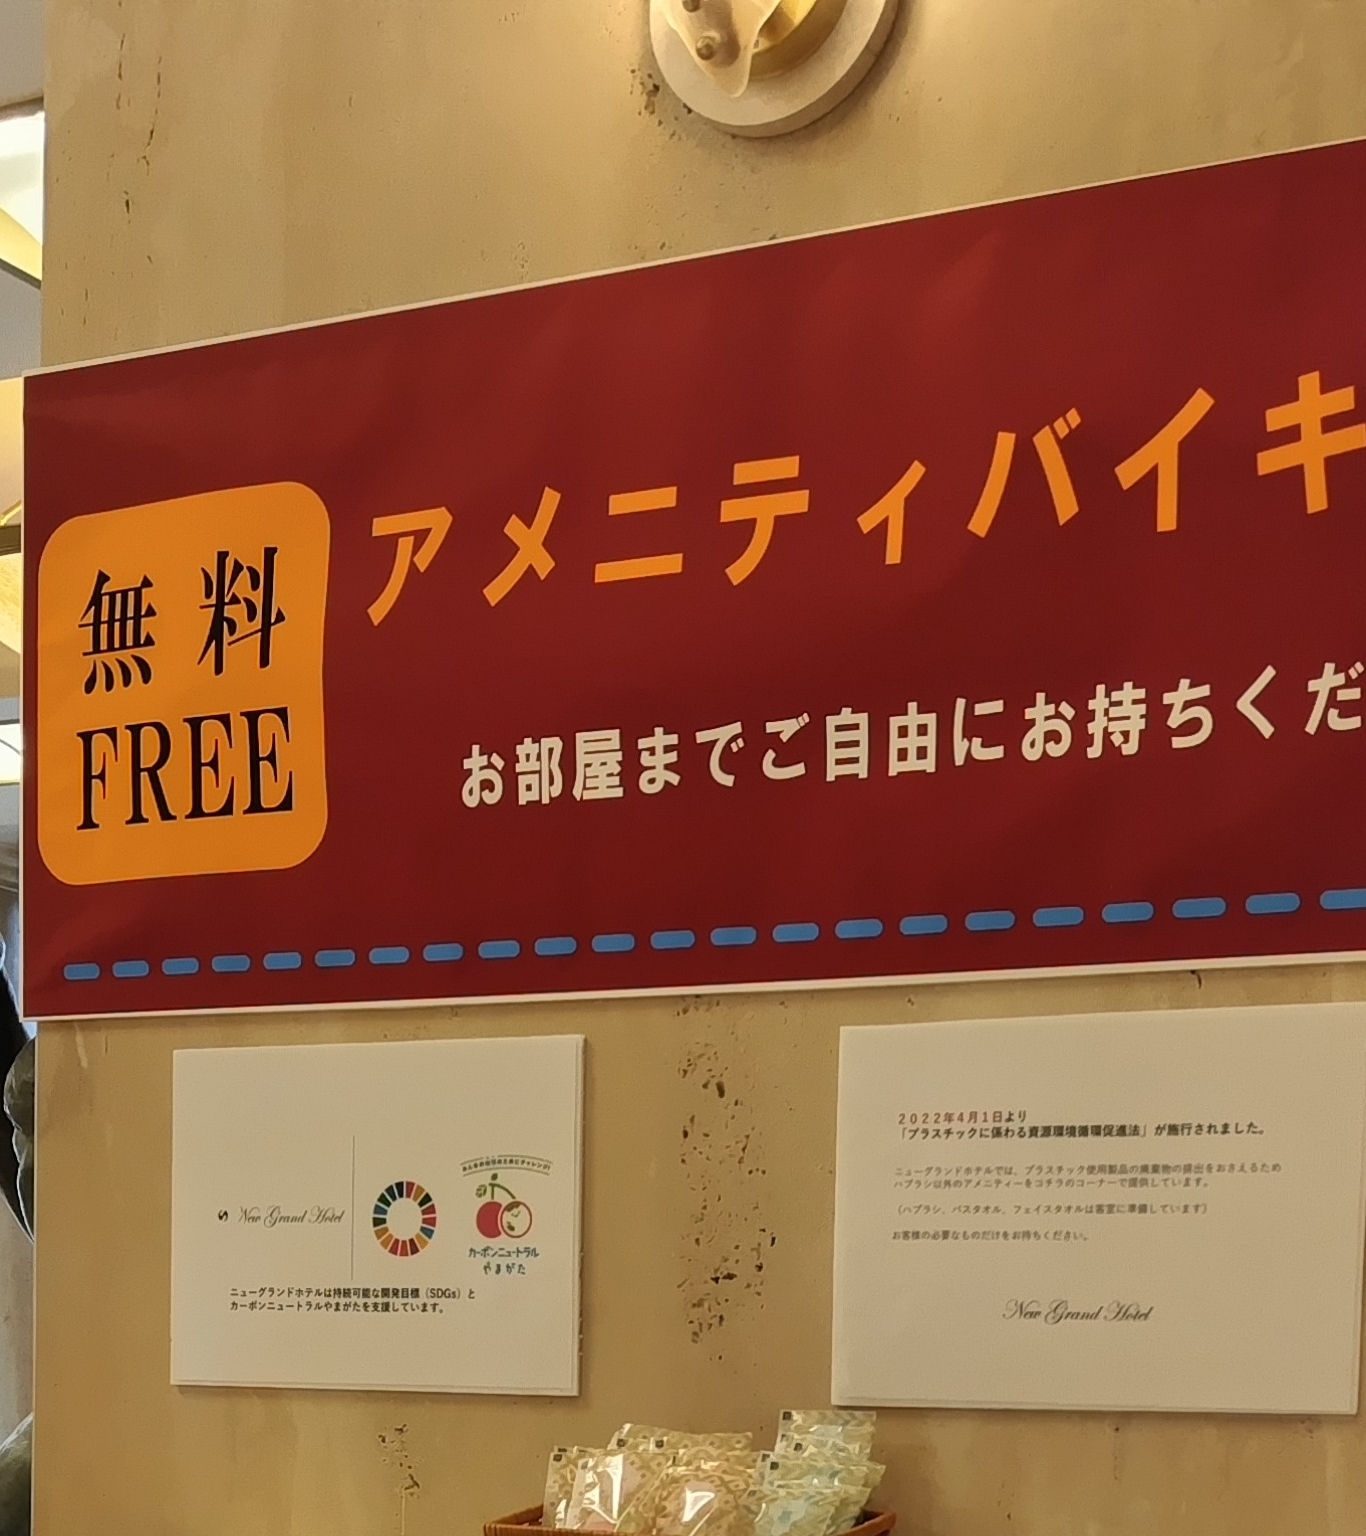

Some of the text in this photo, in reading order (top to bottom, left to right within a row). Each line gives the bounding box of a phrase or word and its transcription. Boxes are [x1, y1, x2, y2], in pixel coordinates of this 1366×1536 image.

[78, 547, 285, 694] 無料
[77, 707, 292, 830] FREE
[237, 1204, 346, 1228] New Grand Hotel
[1003, 1300, 1154, 1324] New Grand Hotel
